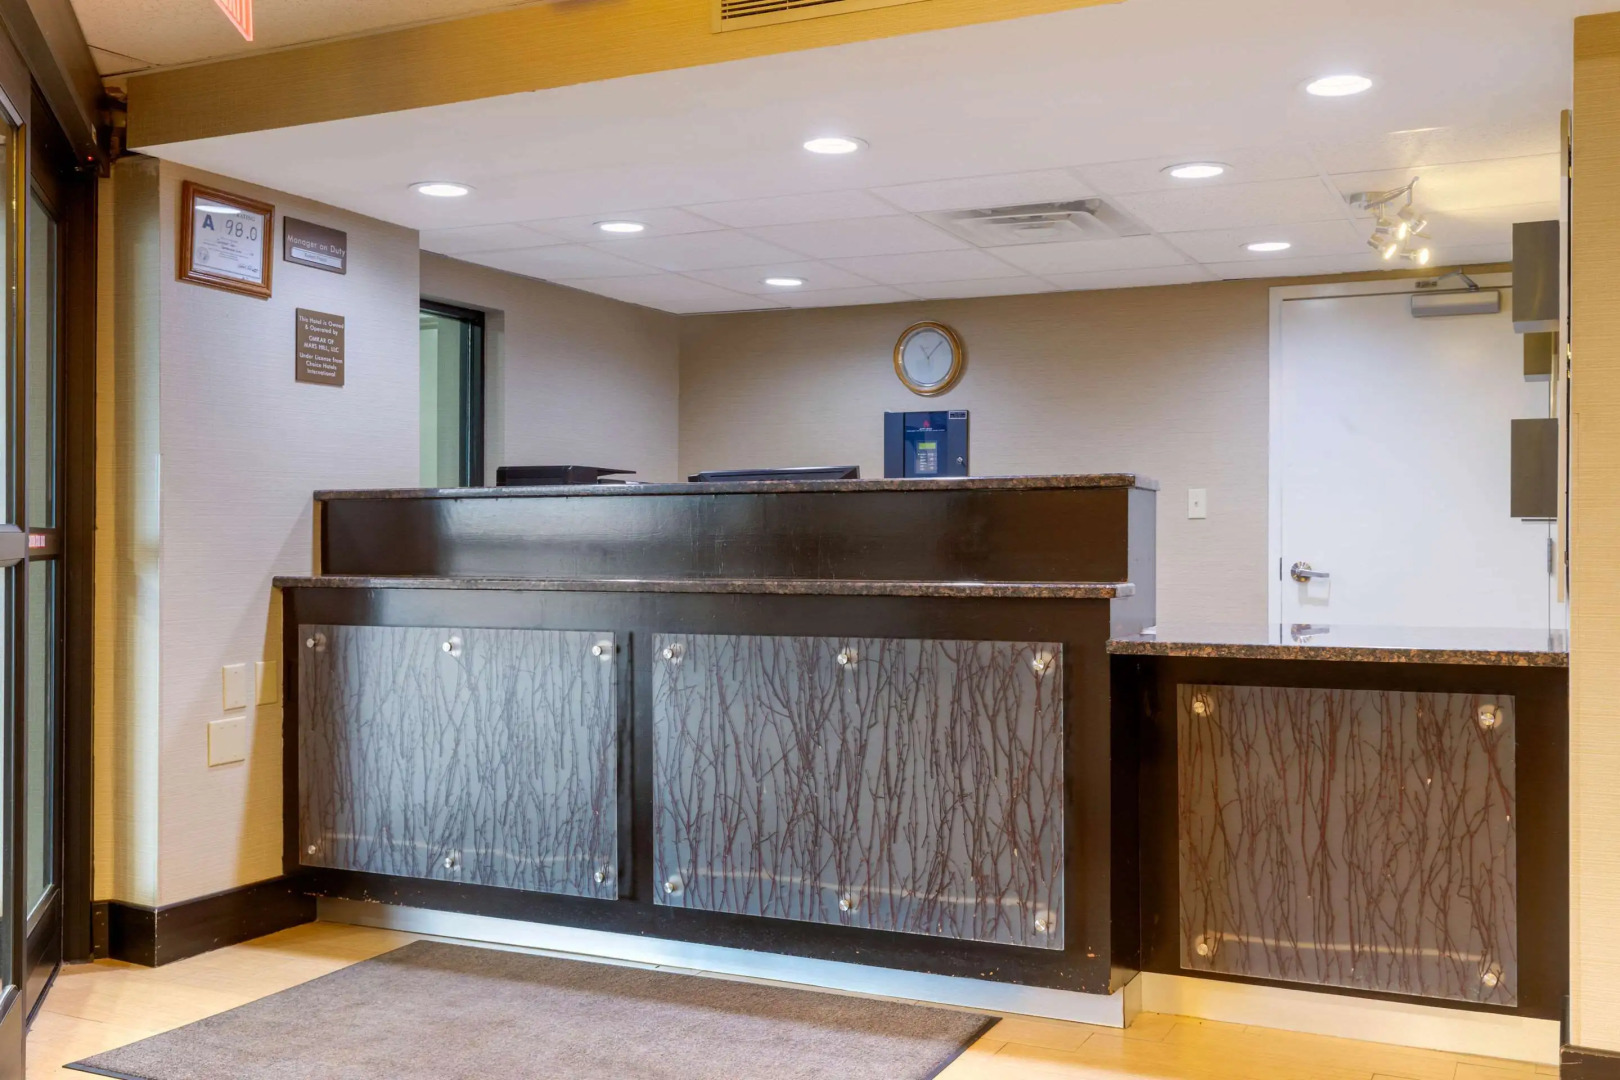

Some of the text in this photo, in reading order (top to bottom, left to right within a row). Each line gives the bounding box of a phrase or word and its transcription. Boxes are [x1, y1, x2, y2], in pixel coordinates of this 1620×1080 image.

[202, 214, 215, 231] A
[225, 219, 258, 241] 98.0
[287, 234, 317, 249] Manager
[330, 245, 346, 258] Duty
[299, 315, 309, 323] This
[328, 320, 344, 329] Owned
[309, 325, 332, 334] Operated
[303, 342, 318, 350] MARS
[318, 344, 330, 352] HILL,
[299, 351, 343, 364] Under License from
[305, 360, 337, 370] Choice Hotels
[306, 368, 336, 377] International
